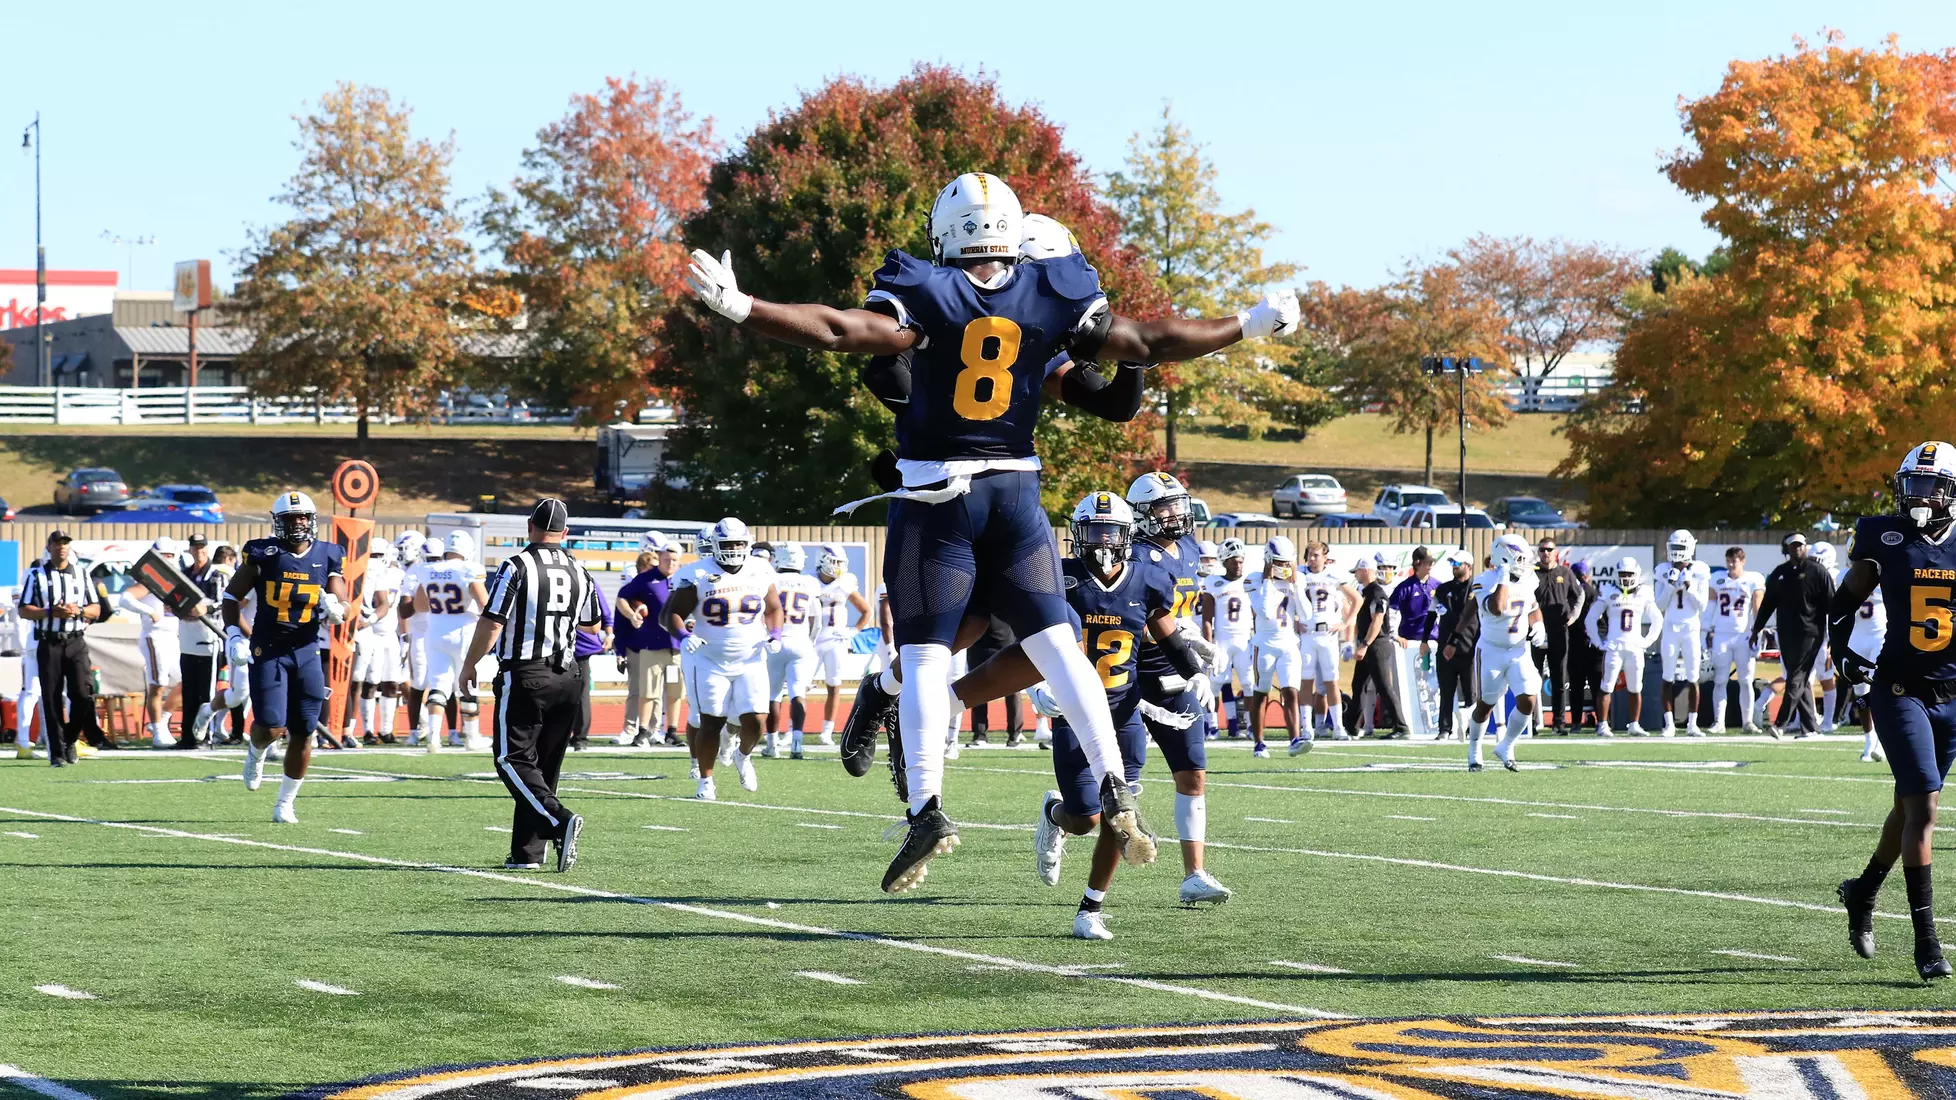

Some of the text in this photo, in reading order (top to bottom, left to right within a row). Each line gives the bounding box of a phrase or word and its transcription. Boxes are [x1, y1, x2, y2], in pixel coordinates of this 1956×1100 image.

[960, 245, 1009, 255] MURRAY STATE
[953, 316, 1022, 421] 8
[141, 563, 174, 594] 1
[283, 571, 310, 581] RACERS
[430, 571, 452, 580] CROSS
[1914, 568, 1956, 580] RACERS
[265, 581, 321, 623] 47
[426, 583, 465, 615] 62
[546, 568, 571, 612] B
[702, 595, 762, 626] 99
[1228, 597, 1241, 622] 8
[1508, 600, 1524, 633] 7
[1719, 593, 1746, 617] 24
[1909, 585, 1954, 652] 5
[1086, 614, 1122, 625] RACERS
[1621, 609, 1633, 632] 0
